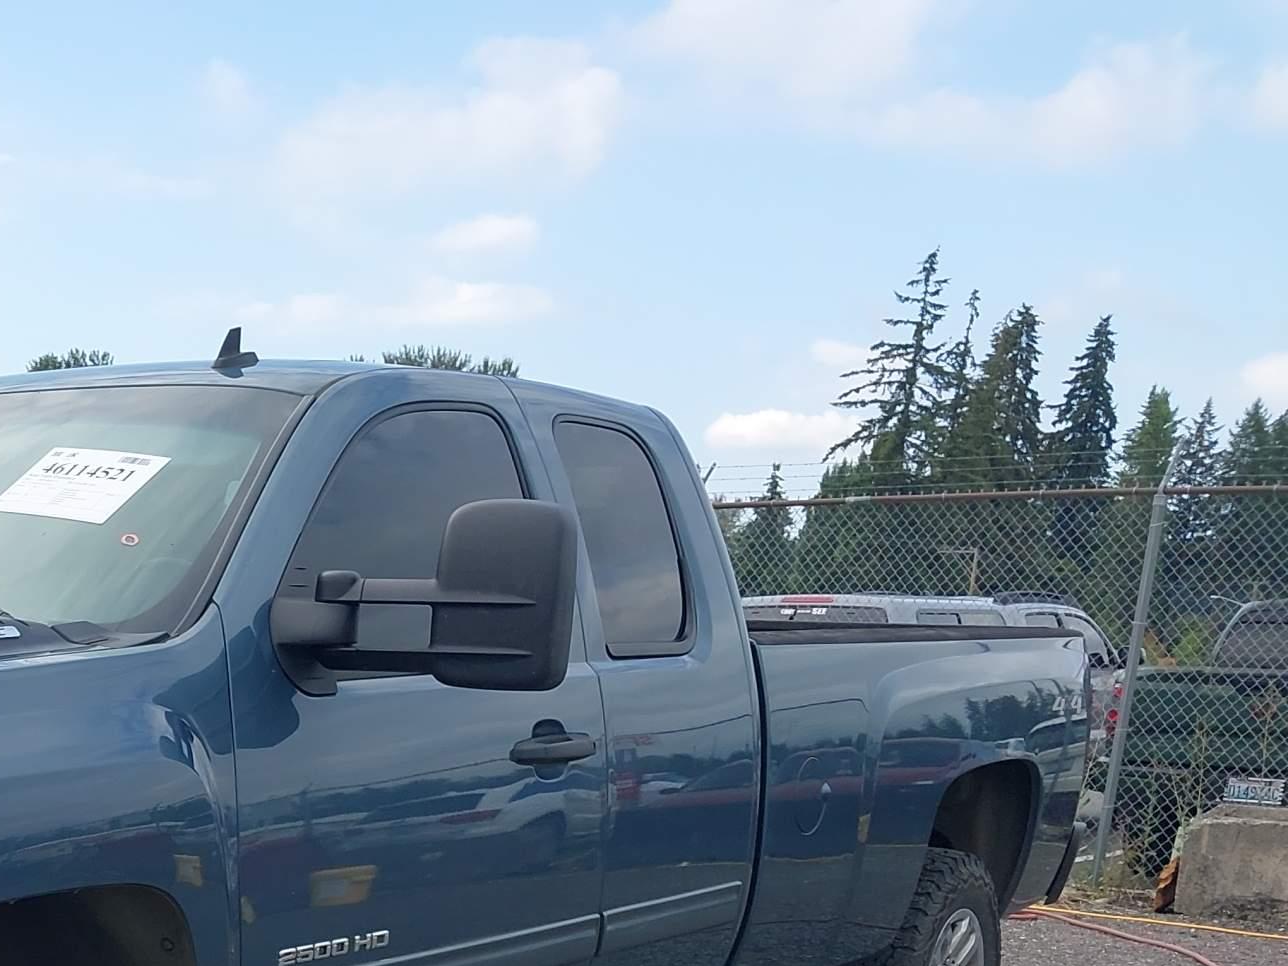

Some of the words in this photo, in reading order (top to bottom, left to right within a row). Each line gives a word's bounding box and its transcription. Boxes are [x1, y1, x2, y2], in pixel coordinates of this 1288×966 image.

[42, 462, 136, 482] 46114521
[278, 937, 349, 966] 2500
[354, 930, 390, 952] HD
